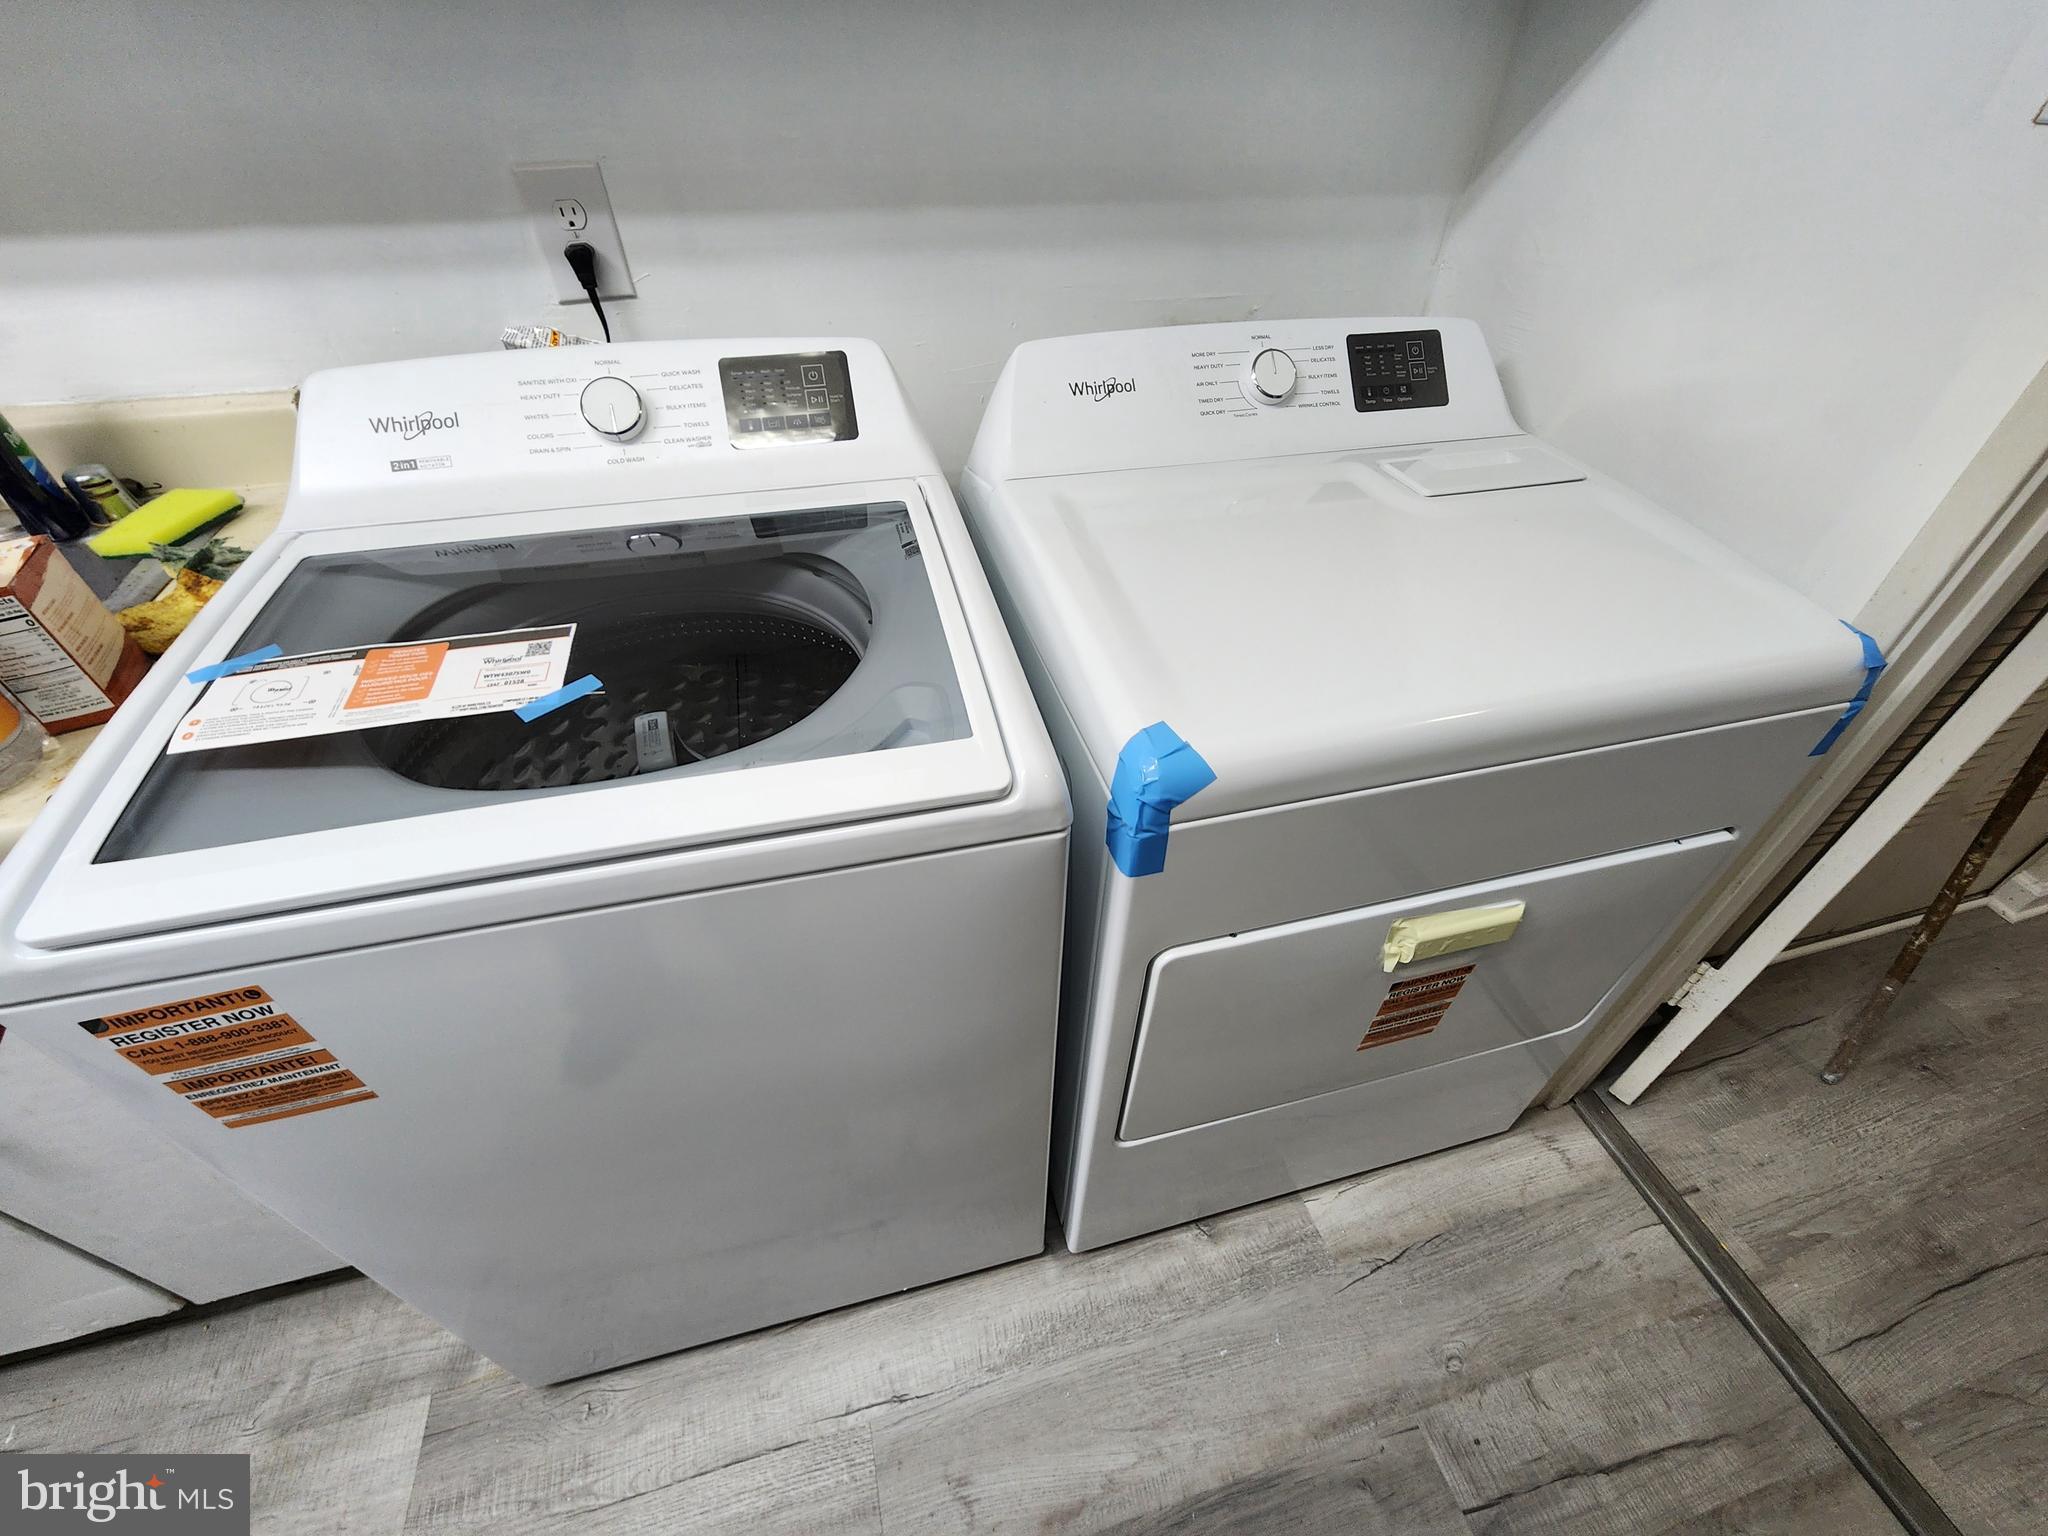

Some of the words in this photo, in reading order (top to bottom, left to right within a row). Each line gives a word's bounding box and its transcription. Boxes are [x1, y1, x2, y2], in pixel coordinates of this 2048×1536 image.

[668, 383, 704, 391] DELICATES
[1068, 377, 1136, 402] Whirlpool
[368, 411, 460, 439] Whirlpool
[527, 432, 555, 440] COLORS
[530, 447, 550, 455] DRAIN
[607, 457, 626, 465] COLD
[626, 456, 646, 464] WASH
[1388, 982, 1440, 1000] REGISTER
[1441, 975, 1466, 986] NOW
[107, 990, 245, 1029] IMPORTANT!
[109, 1017, 222, 1048] REGISTER
[222, 1004, 274, 1024] NOW
[126, 1044, 174, 1059] CALL
[174, 1018, 291, 1049] 1-888-900-3381
[181, 1055, 318, 1091] IMPORTANTE!
[184, 1080, 267, 1101] ENREGISTREZ
[266, 1062, 342, 1085] MAINTENANT
